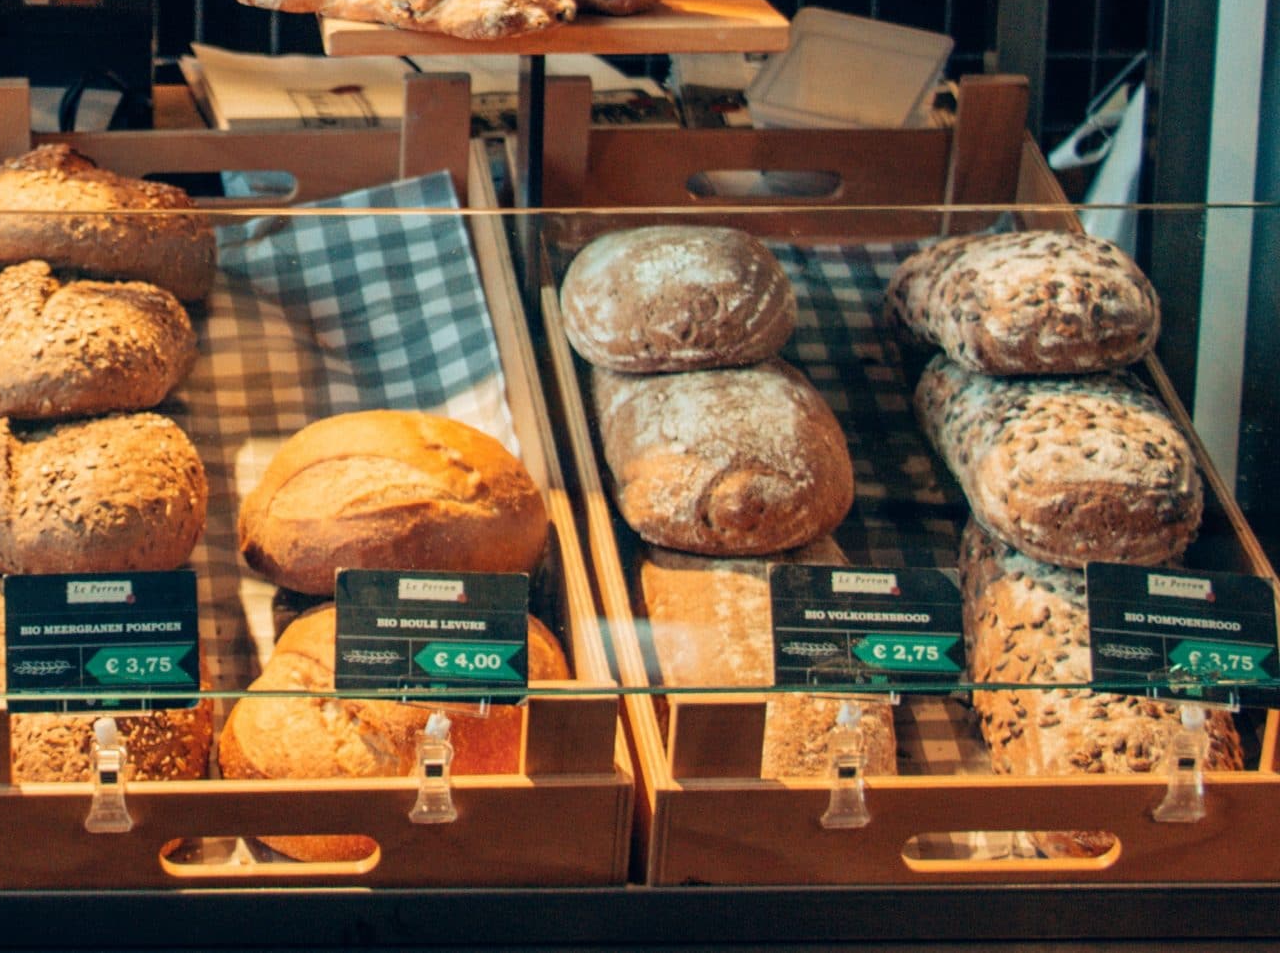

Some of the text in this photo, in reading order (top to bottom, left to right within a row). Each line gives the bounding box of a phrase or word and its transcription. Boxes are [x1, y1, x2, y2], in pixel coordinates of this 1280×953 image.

[422, 582, 457, 592] Perron
[855, 576, 889, 585] Perron
[1169, 579, 1205, 590] Perron
[90, 584, 126, 593] Perron
[376, 617, 487, 631] BIO BOULE LEVURE
[804, 609, 931, 624] BIO VOLKORENBROOD
[1123, 612, 1242, 632] BIO POMPOENBROOD
[21, 621, 182, 636] BIO MEERGRANEN POMPOEN
[872, 643, 940, 663] € 2,75
[105, 656, 173, 676] € 3,75
[433, 652, 501, 670] € 4,00
